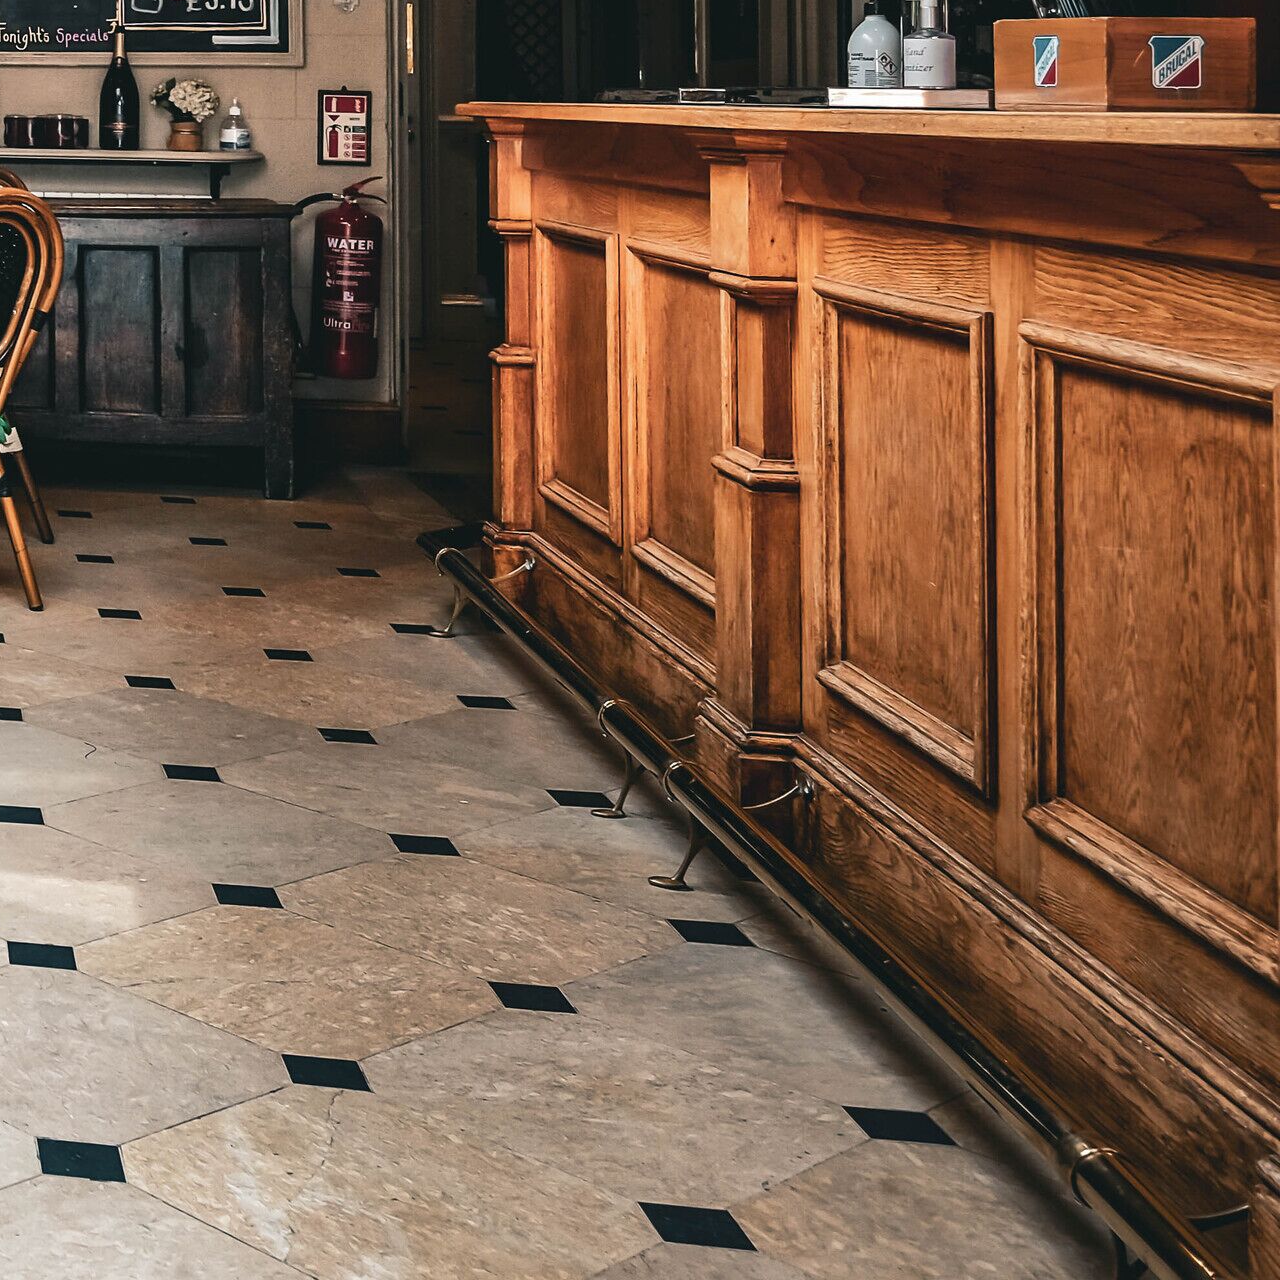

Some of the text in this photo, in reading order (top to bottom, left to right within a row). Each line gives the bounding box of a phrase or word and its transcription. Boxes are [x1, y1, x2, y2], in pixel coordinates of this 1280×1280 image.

[56, 27, 109, 48] Specials
[1158, 40, 1198, 85] BRUGAL
[327, 236, 374, 250] WATER
